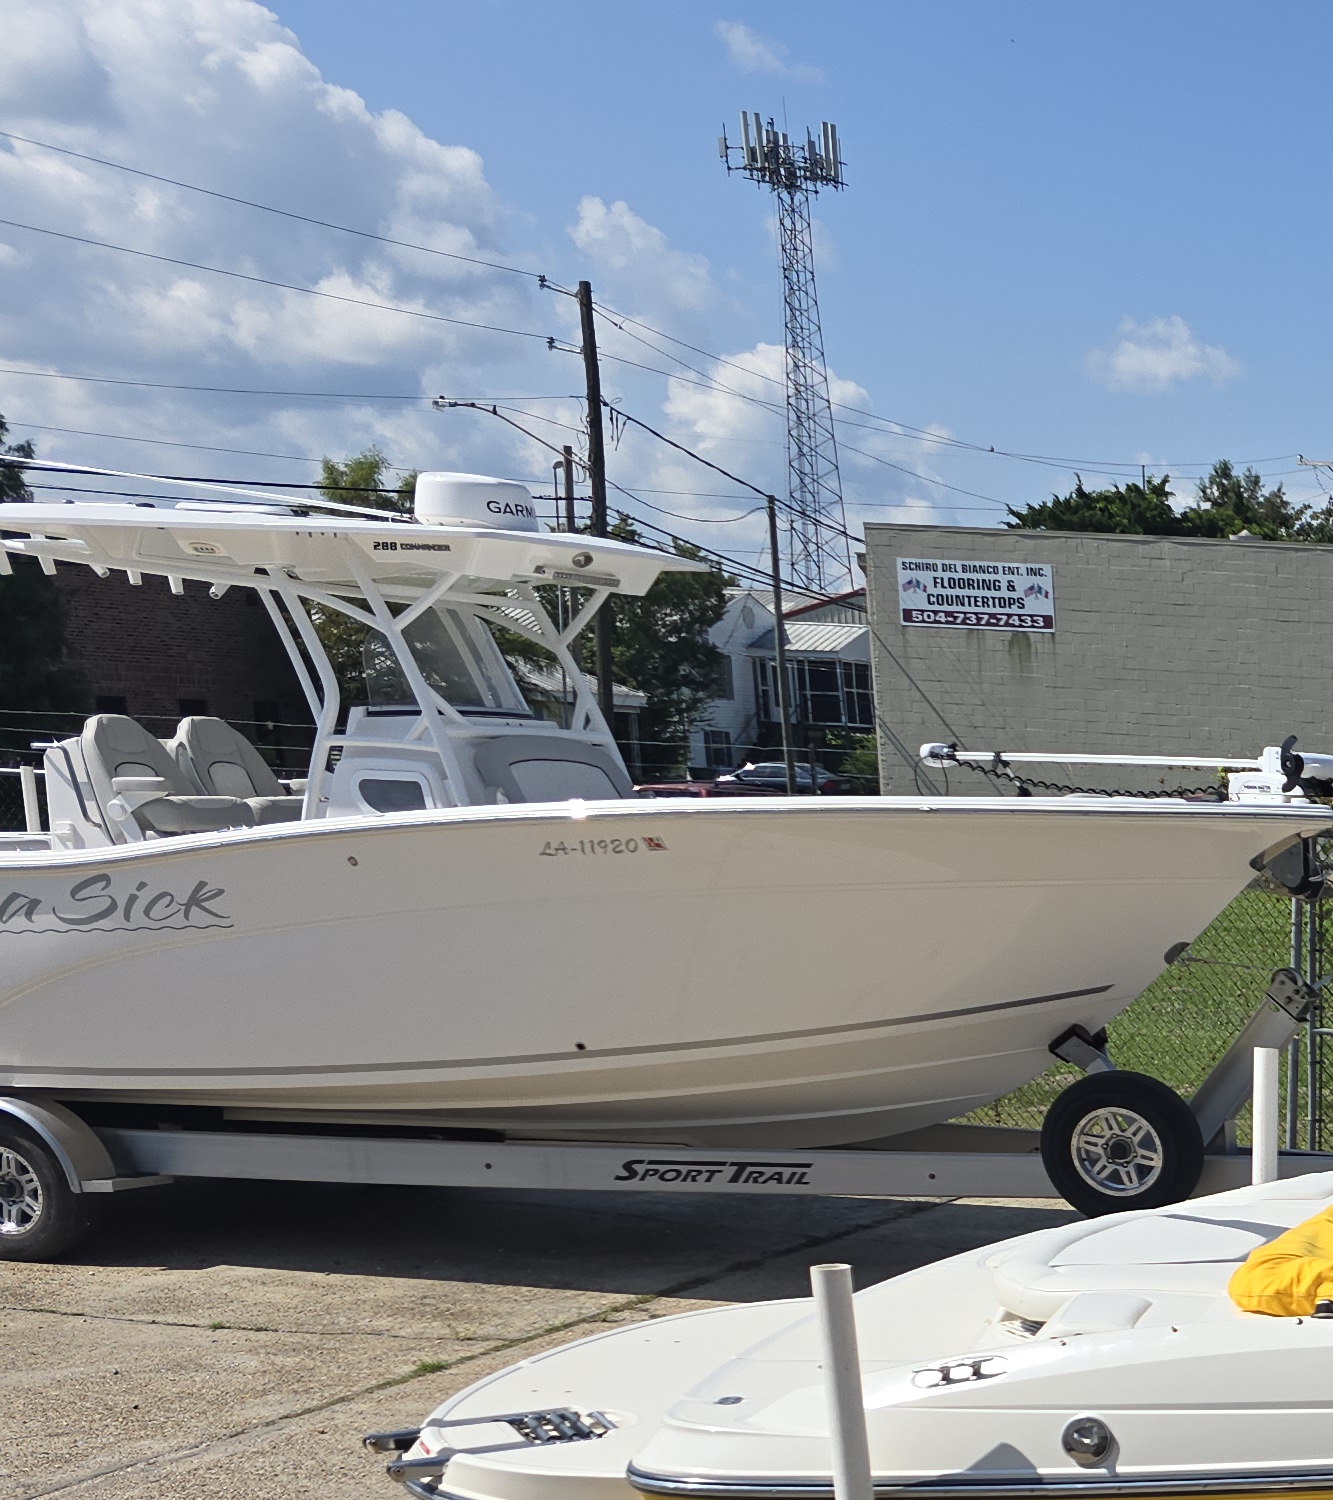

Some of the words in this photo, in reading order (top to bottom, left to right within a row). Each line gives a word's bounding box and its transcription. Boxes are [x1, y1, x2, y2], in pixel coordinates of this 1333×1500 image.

[486, 500, 535, 518] GARM
[373, 541, 397, 551] 288
[901, 561, 938, 573] SCHIRO
[941, 563, 959, 573] DEL
[961, 564, 999, 575] BIANCO
[1002, 566, 1023, 576] ENT.
[1026, 567, 1048, 577] INC.
[933, 576, 1001, 592] FLOORING
[1006, 579, 1017, 592] &
[927, 593, 1025, 609] COUNTERTOPS
[912, 610, 1045, 627] 504-737-7433
[52, 873, 232, 926] Sick
[614, 1159, 728, 1184] SPORT
[727, 1161, 814, 1185] TRAIL
